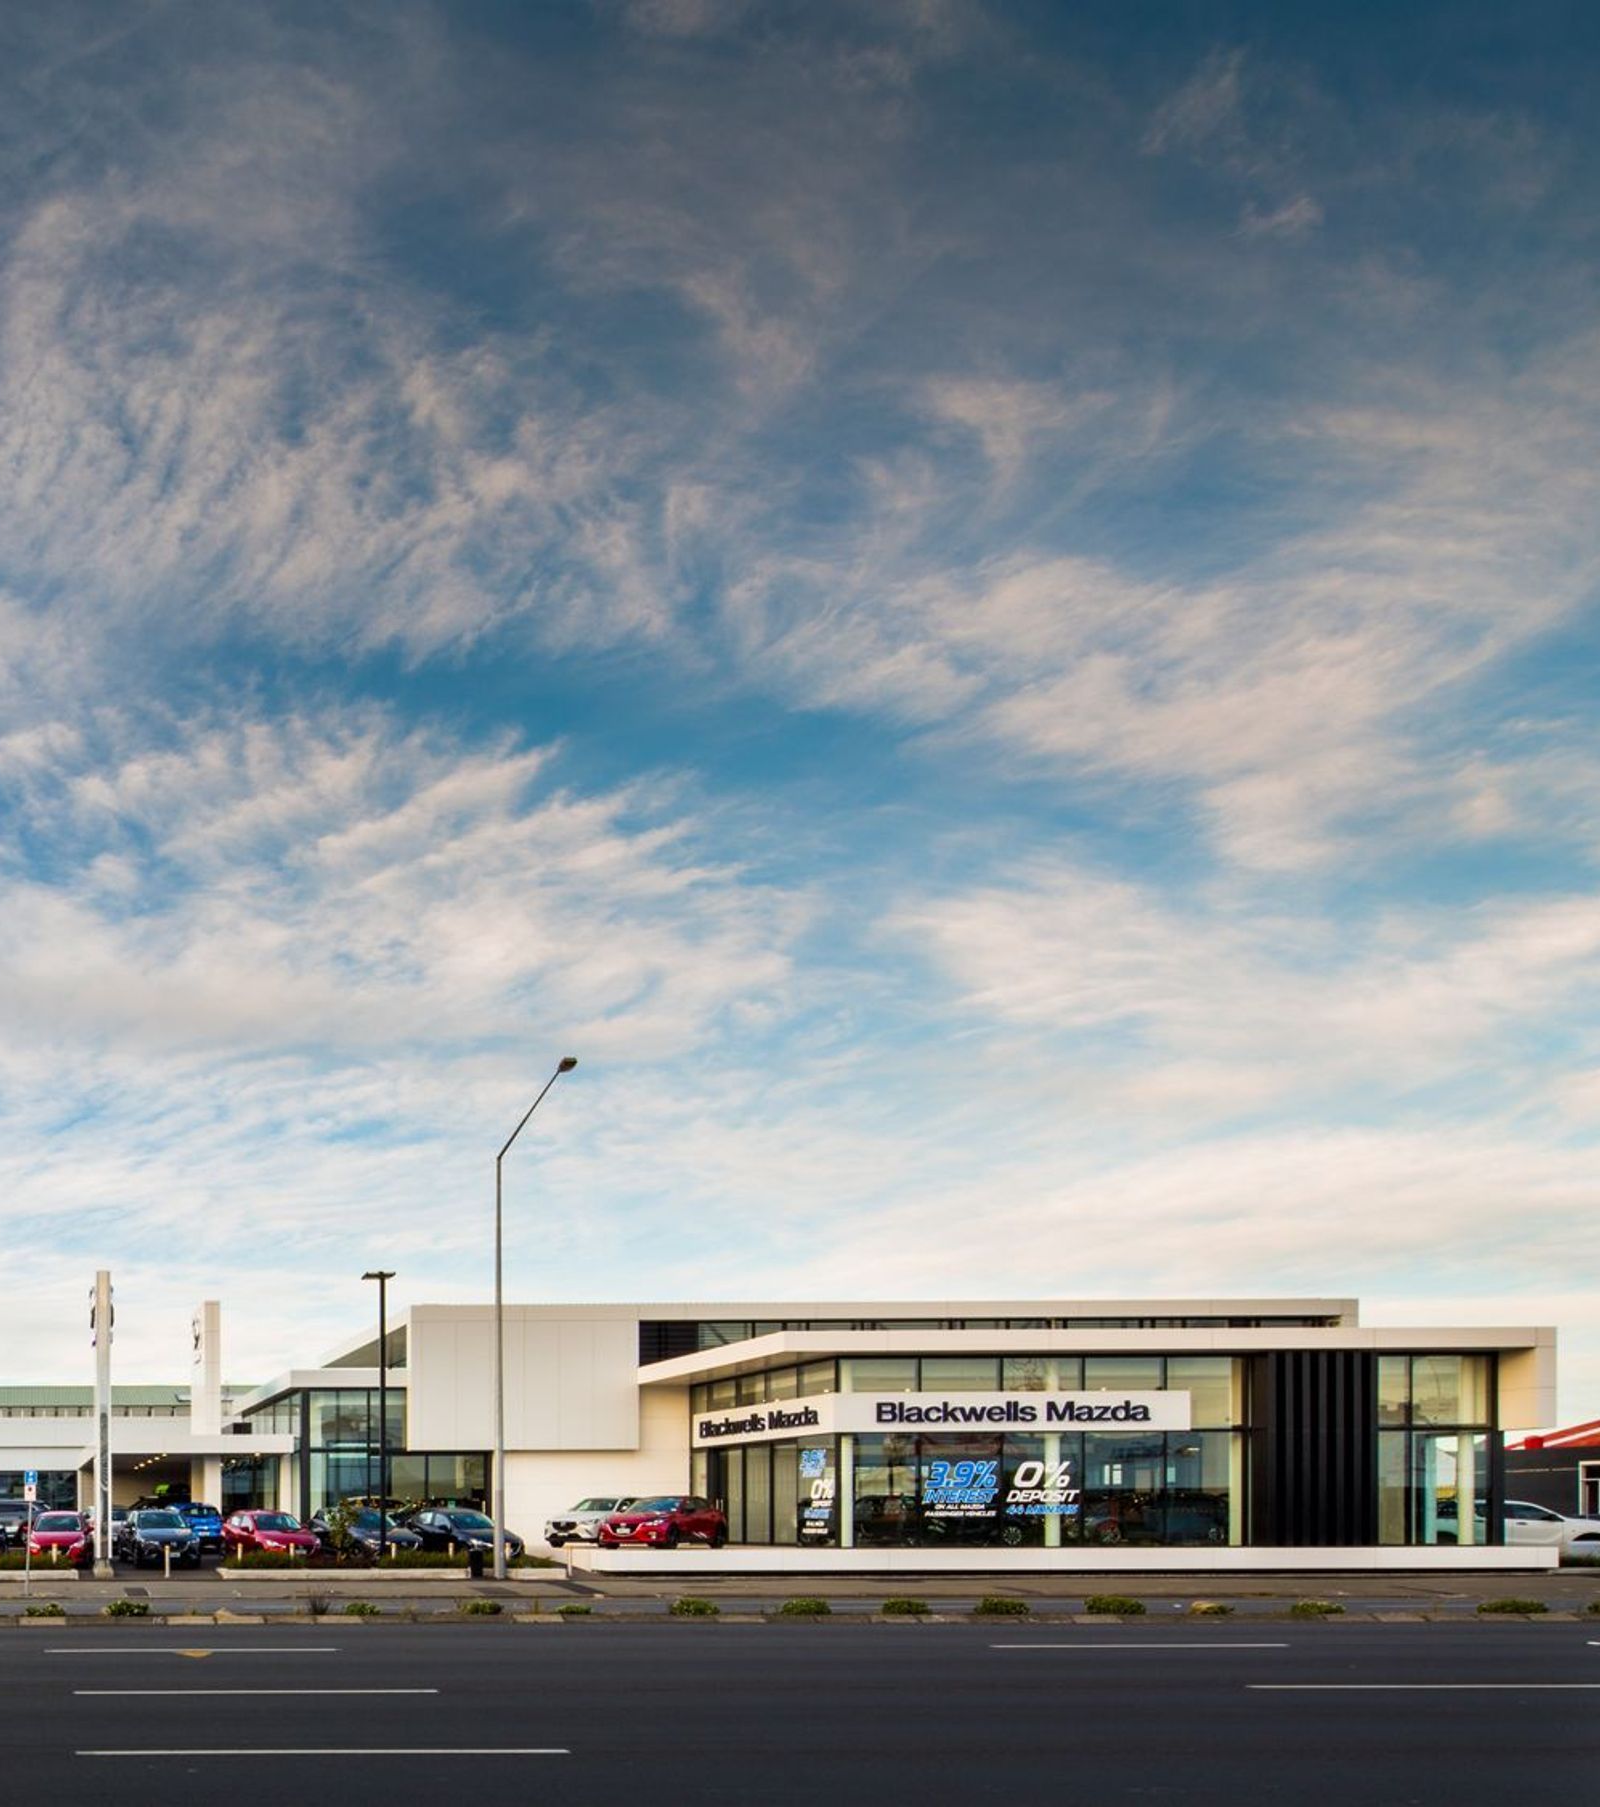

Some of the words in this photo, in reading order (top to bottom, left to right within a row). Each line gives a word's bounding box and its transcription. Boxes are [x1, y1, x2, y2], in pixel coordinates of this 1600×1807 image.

[700, 1413, 766, 1438] Blackwells
[768, 1406, 819, 1429] Mazda
[876, 1401, 1037, 1423] Blackwells
[1046, 1401, 1150, 1422] Mazda
[925, 1461, 998, 1488] 3.9%
[1013, 1461, 1071, 1488] 0%
[922, 1488, 999, 1504] INTEREST
[1006, 1490, 1080, 1502] DEPOSIT
